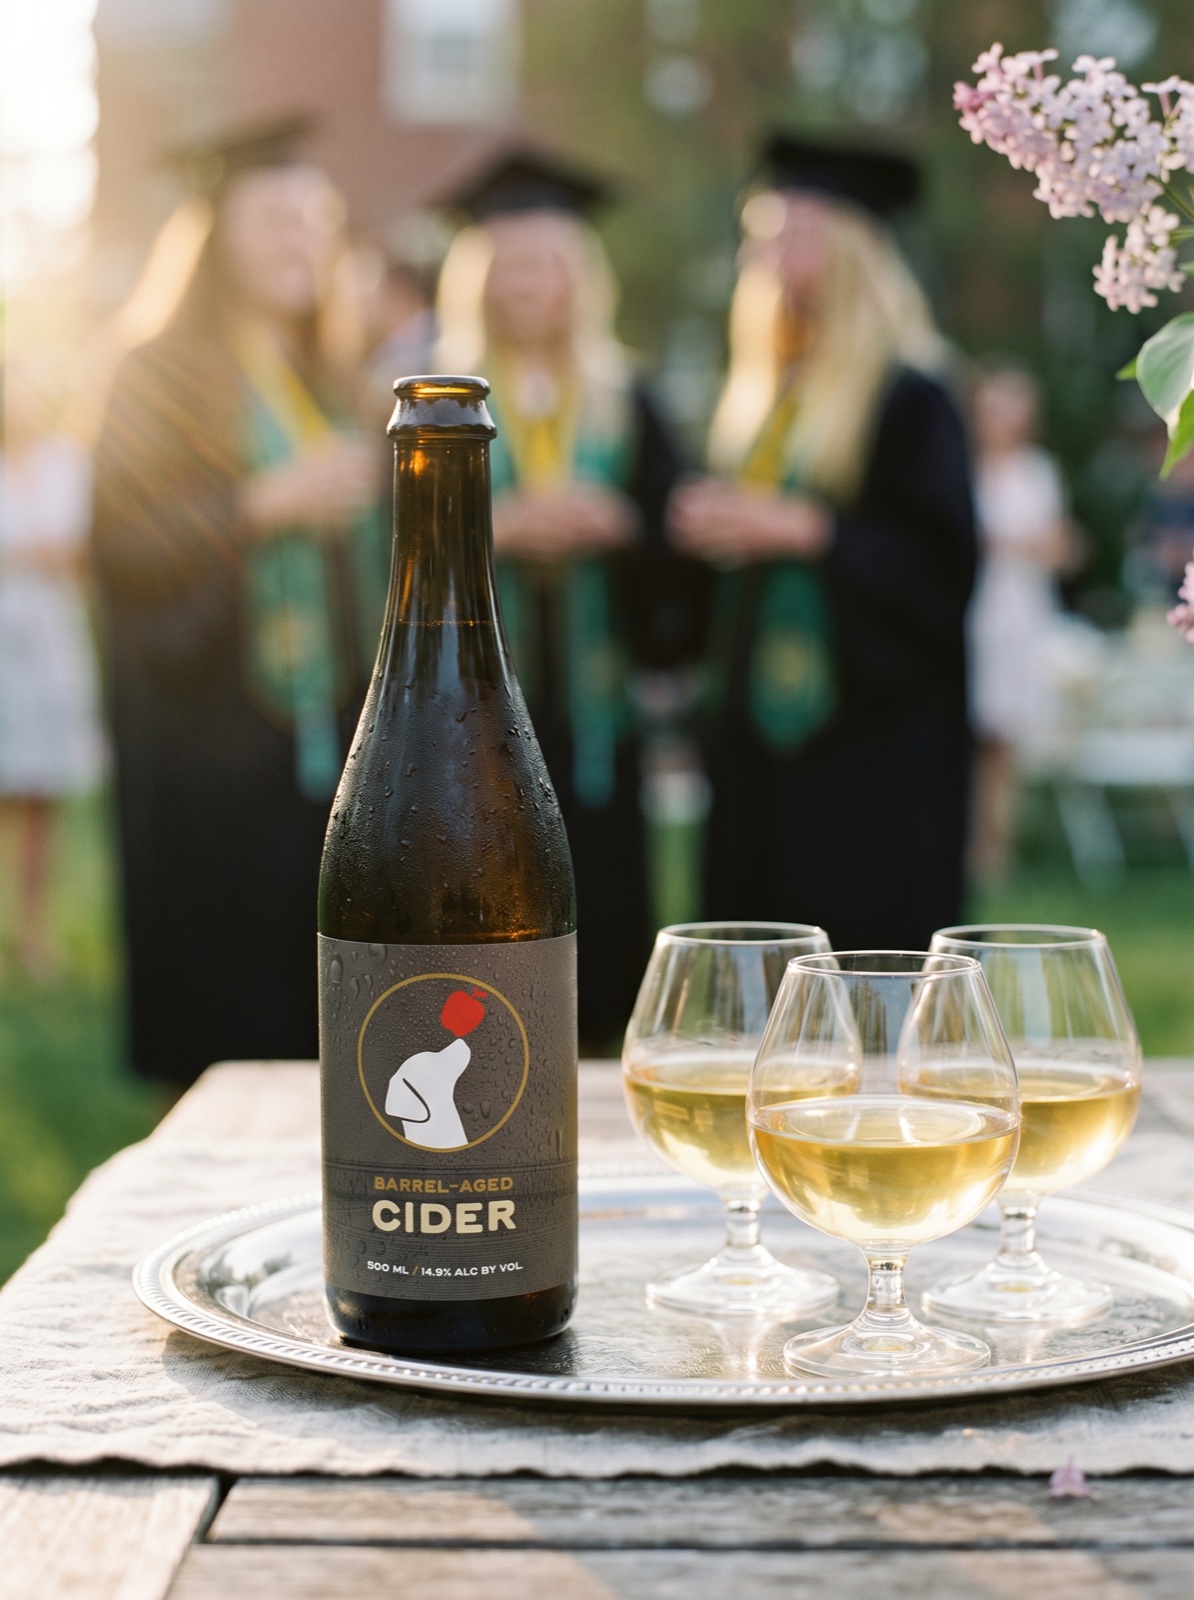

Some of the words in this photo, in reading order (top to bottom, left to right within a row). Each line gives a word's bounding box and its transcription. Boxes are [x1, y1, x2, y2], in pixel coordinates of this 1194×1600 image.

[374, 1176, 514, 1194] BARREL-AGED
[372, 1199, 517, 1234] CIDER
[367, 1260, 390, 1272] 500
[392, 1264, 409, 1275] ML
[421, 1266, 452, 1277] 14.9%
[454, 1266, 479, 1277] ALC
[481, 1264, 497, 1275] BY
[499, 1261, 523, 1273] VOL
